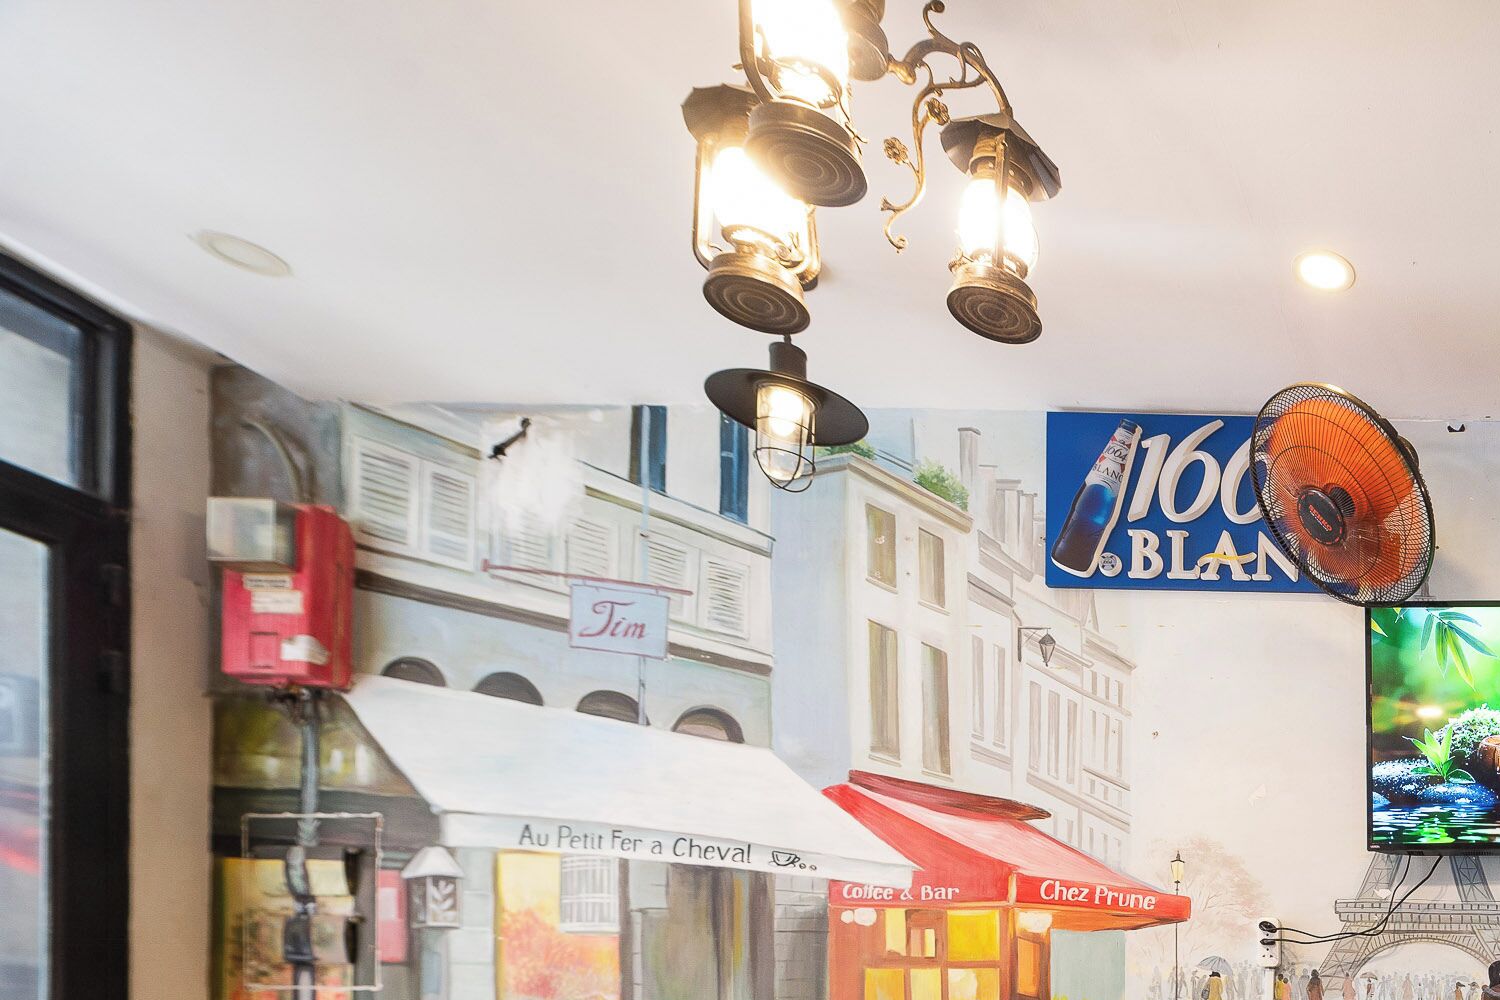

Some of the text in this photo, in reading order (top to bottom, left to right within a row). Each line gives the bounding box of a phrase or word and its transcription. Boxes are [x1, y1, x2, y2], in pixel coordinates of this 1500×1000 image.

[1127, 419, 1266, 524] 166
[1127, 529, 1299, 583] BLAN
[577, 600, 647, 639] Tim
[518, 824, 753, 864] Au Petit Fer a Cheval
[842, 883, 960, 900] Coffee & Bar
[1039, 879, 1157, 911] Chez Prune
